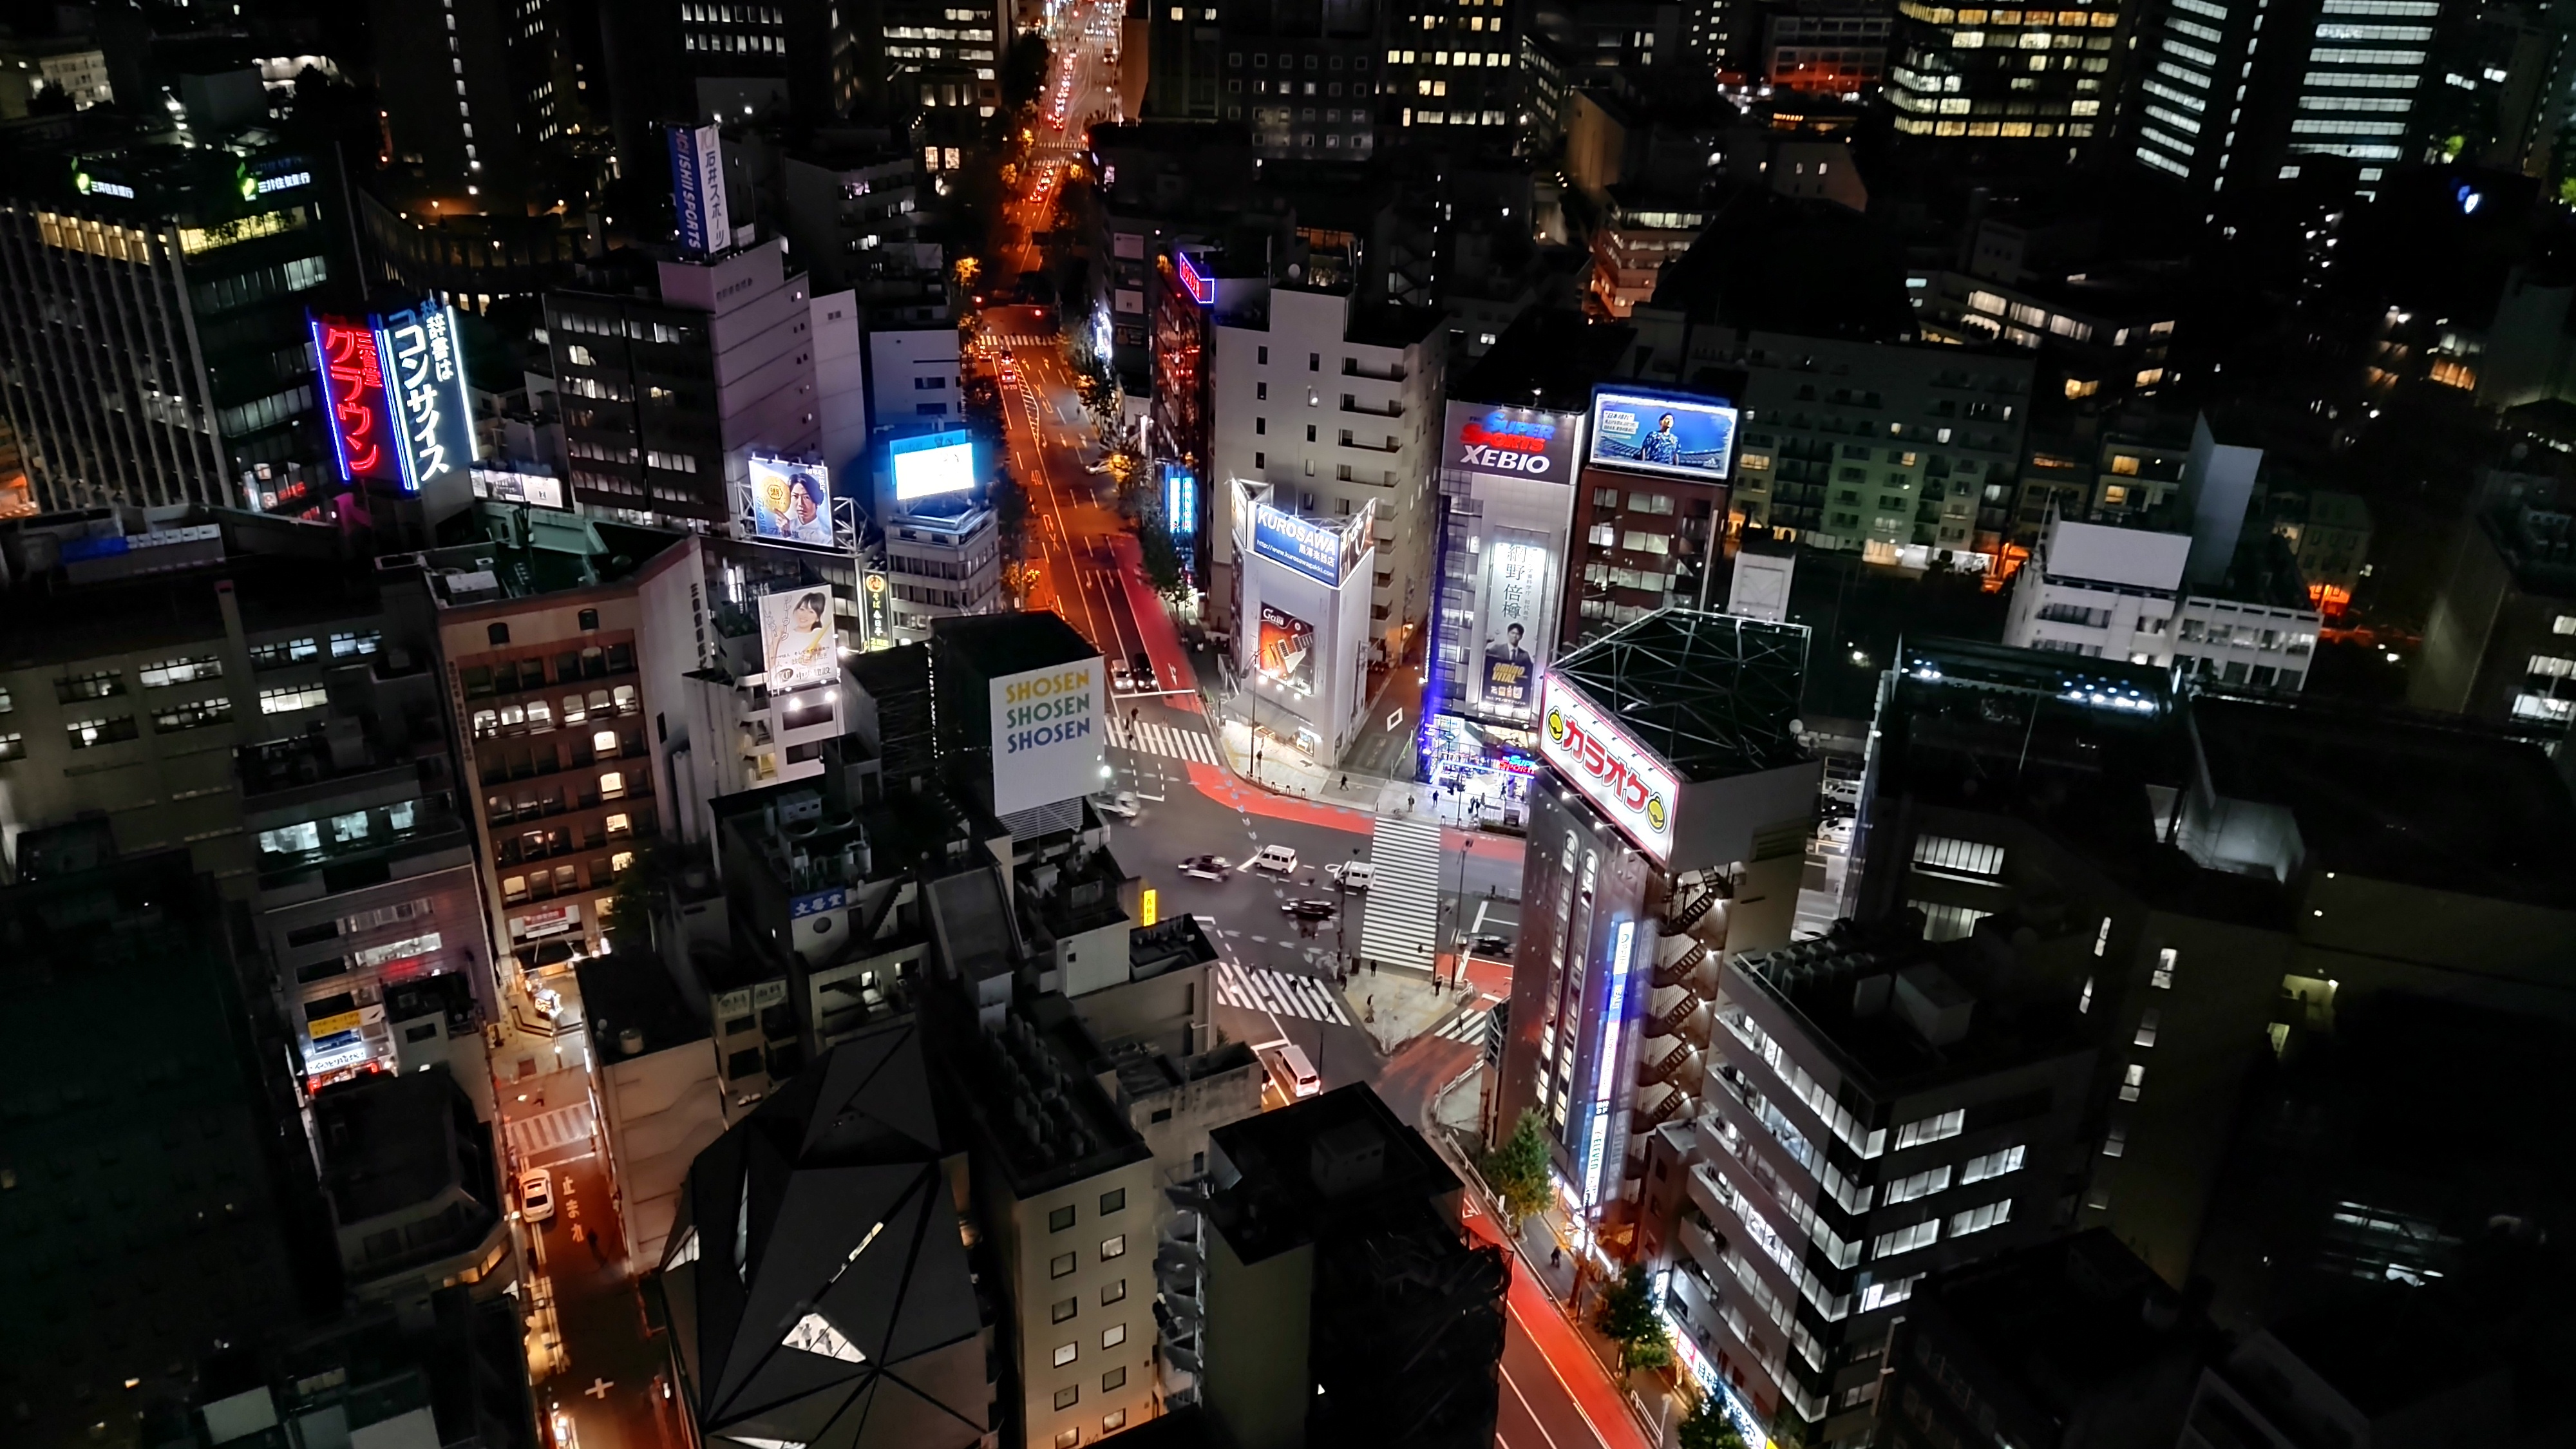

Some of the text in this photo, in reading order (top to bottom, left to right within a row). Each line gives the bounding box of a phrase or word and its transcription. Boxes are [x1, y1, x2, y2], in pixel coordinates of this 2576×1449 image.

[683, 190, 701, 249] SPORTS
[705, 150, 724, 248] 石井スポーツ
[355, 331, 383, 388] 三省堂
[426, 313, 454, 382] 辞書は
[325, 328, 379, 471] クラウン
[395, 324, 450, 482] コンサイス
[1461, 423, 1546, 453] SPORTS
[1485, 412, 1556, 440] SUPER
[1031, 469, 1043, 485] 40
[1460, 444, 1550, 473] XEBIO
[1258, 509, 1336, 556] KUROSAWA
[1256, 538, 1335, 578] http://www.kurosawagakki.com
[781, 594, 792, 641] リレーワーク
[1006, 668, 1089, 705] SHOSEN
[1492, 671, 1517, 684] VITAL
[1493, 662, 1526, 676] amino
[1007, 693, 1090, 730] SHOSEN
[1007, 717, 1090, 754] SHOSEN
[1562, 717, 1651, 812] カラオケ
[563, 1176, 584, 1242] 止まれ
